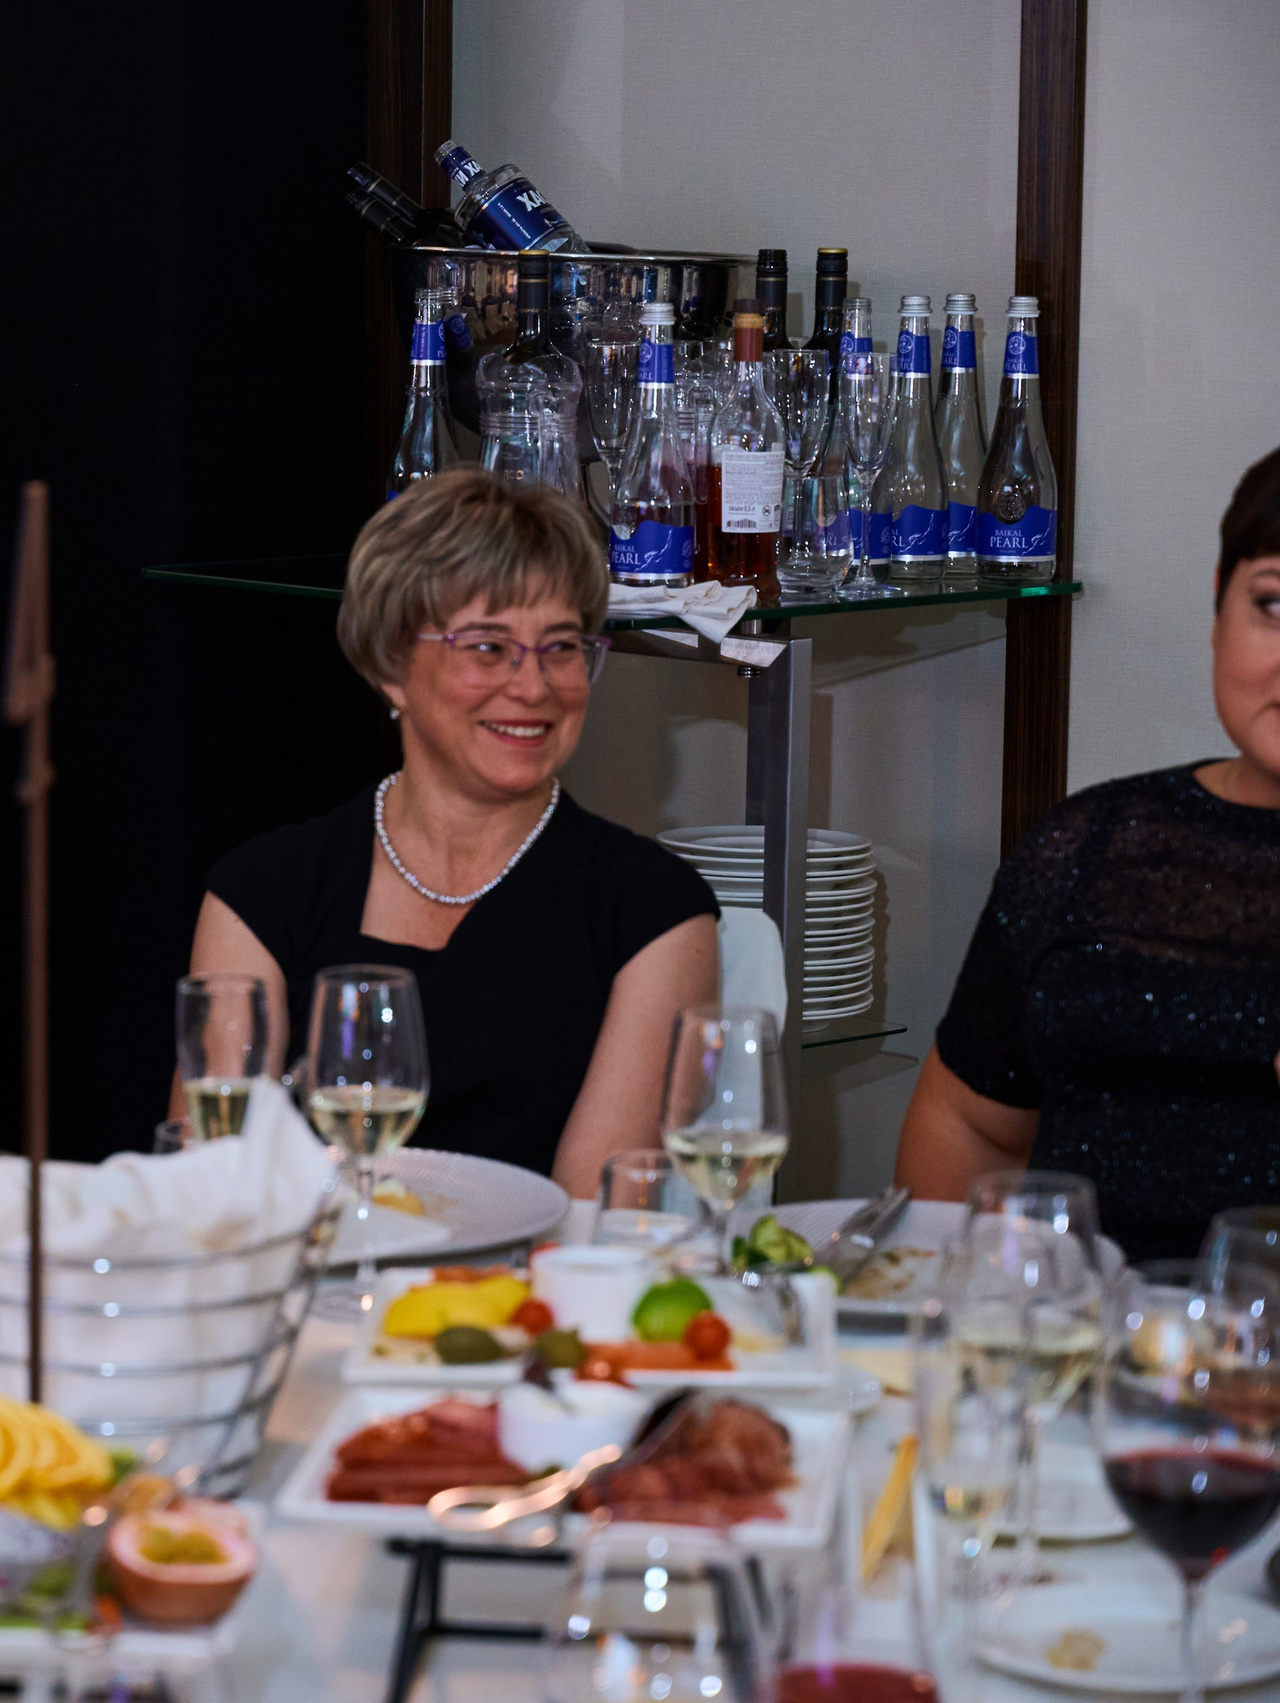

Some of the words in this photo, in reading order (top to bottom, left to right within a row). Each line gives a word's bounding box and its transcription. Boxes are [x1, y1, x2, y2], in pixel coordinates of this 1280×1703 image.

[995, 529, 1023, 537] BAIKAL
[990, 536, 1028, 548] PEARL
[611, 550, 641, 565] PEARL
